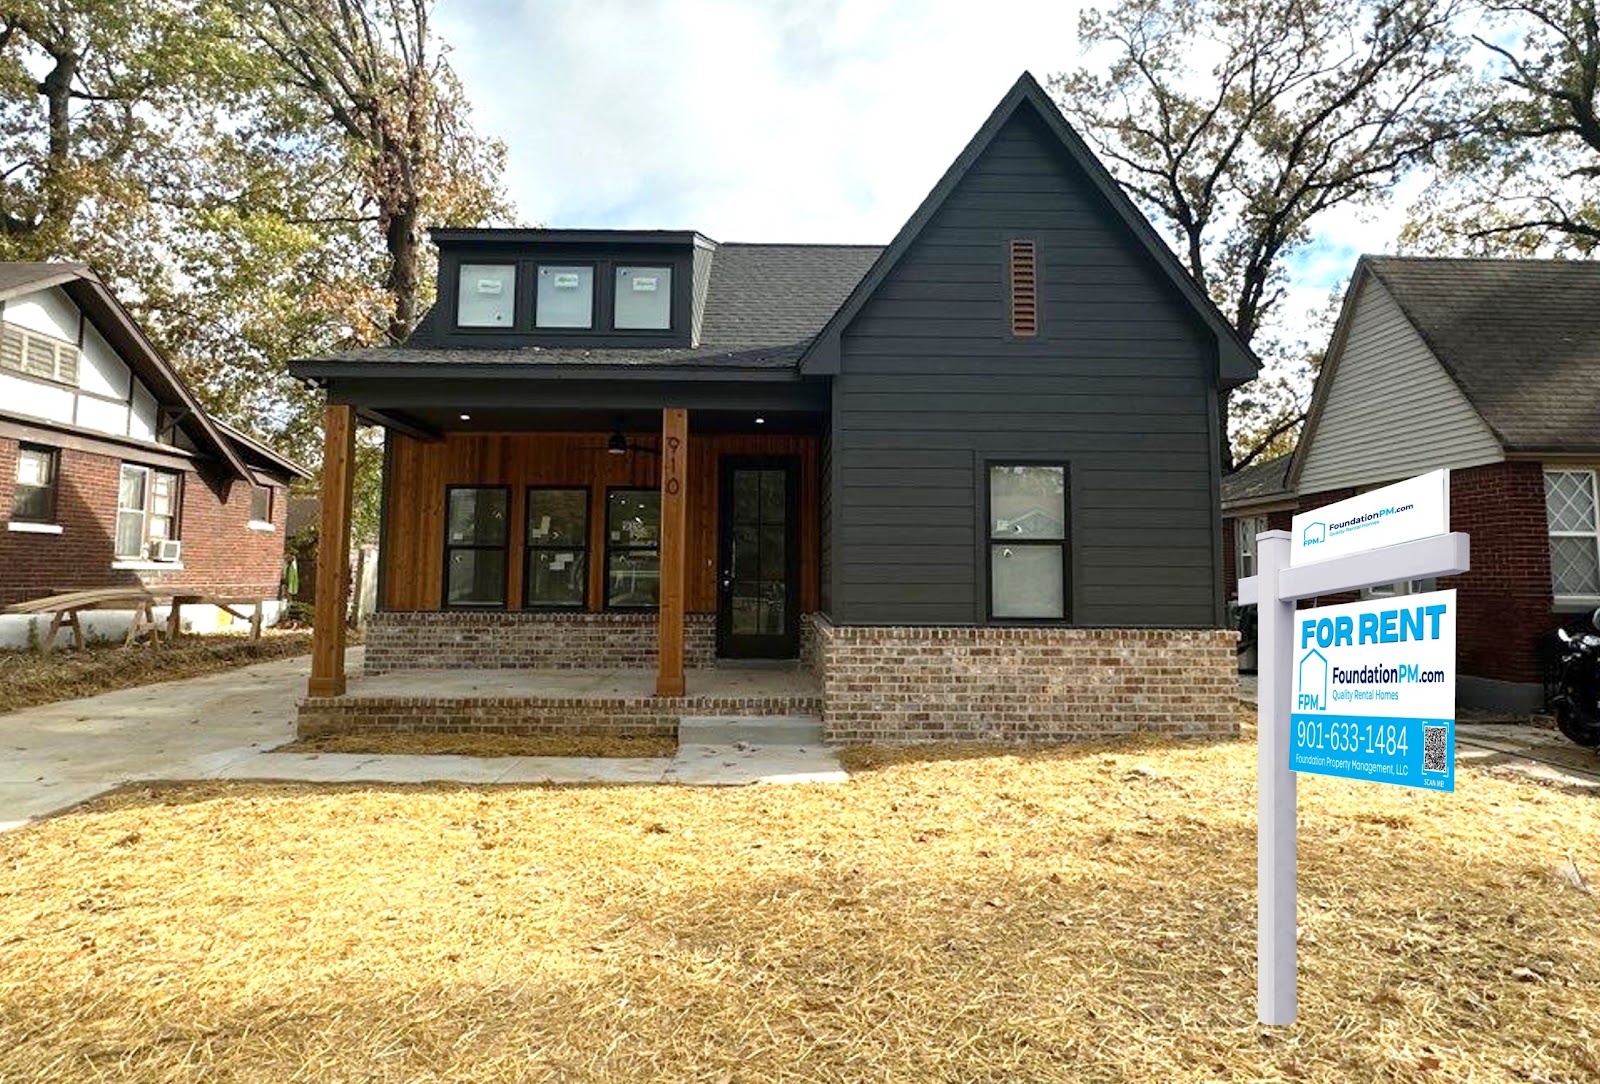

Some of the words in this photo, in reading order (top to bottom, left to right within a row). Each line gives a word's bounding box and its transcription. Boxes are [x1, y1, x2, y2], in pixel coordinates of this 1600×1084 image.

[1329, 503, 1414, 531] FoundationPM.com
[1329, 528, 1345, 537] Quality
[1346, 524, 1361, 532] Rental
[1362, 520, 1380, 528] Homes
[1303, 537, 1319, 547] FPM
[1302, 616, 1354, 649] FOR
[1359, 604, 1446, 645] RENT
[1333, 663, 1445, 684] FoundationPM.com
[1298, 694, 1319, 710] FPM
[1332, 689, 1353, 702] Quality
[1354, 689, 1375, 700] Rental
[1375, 690, 1399, 701] Homes
[1297, 720, 1409, 757] 901-633-1484
[1296, 753, 1326, 767] Foundation
[1326, 756, 1350, 771] Property
[1351, 760, 1395, 776] Management,
[1395, 764, 1409, 777] LLC
[1424, 778, 1436, 787] SCAN
